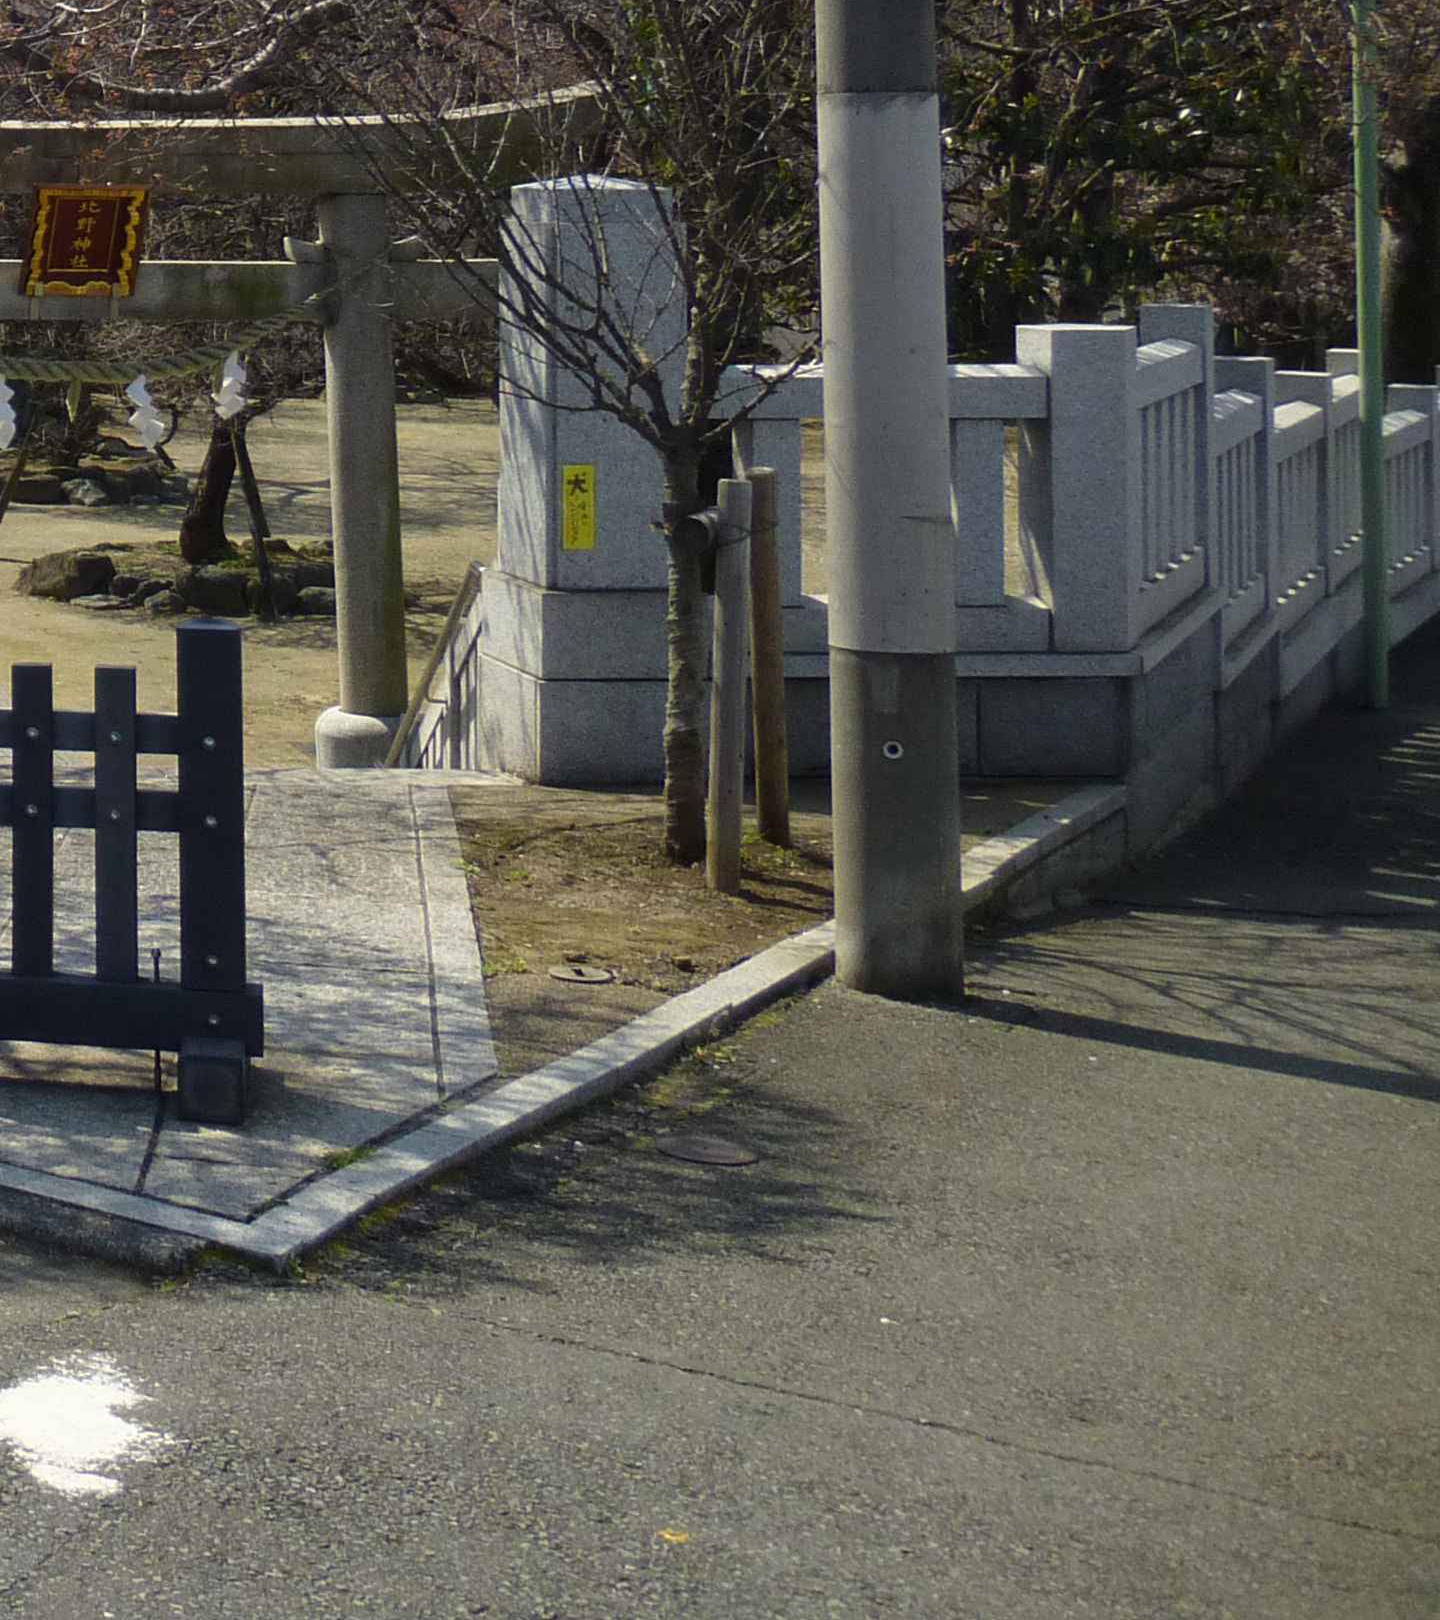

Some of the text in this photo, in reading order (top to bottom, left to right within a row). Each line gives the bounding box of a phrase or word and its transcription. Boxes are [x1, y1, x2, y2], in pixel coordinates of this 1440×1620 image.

[71, 200, 101, 269] 北野神社
[567, 471, 588, 496] 犬
